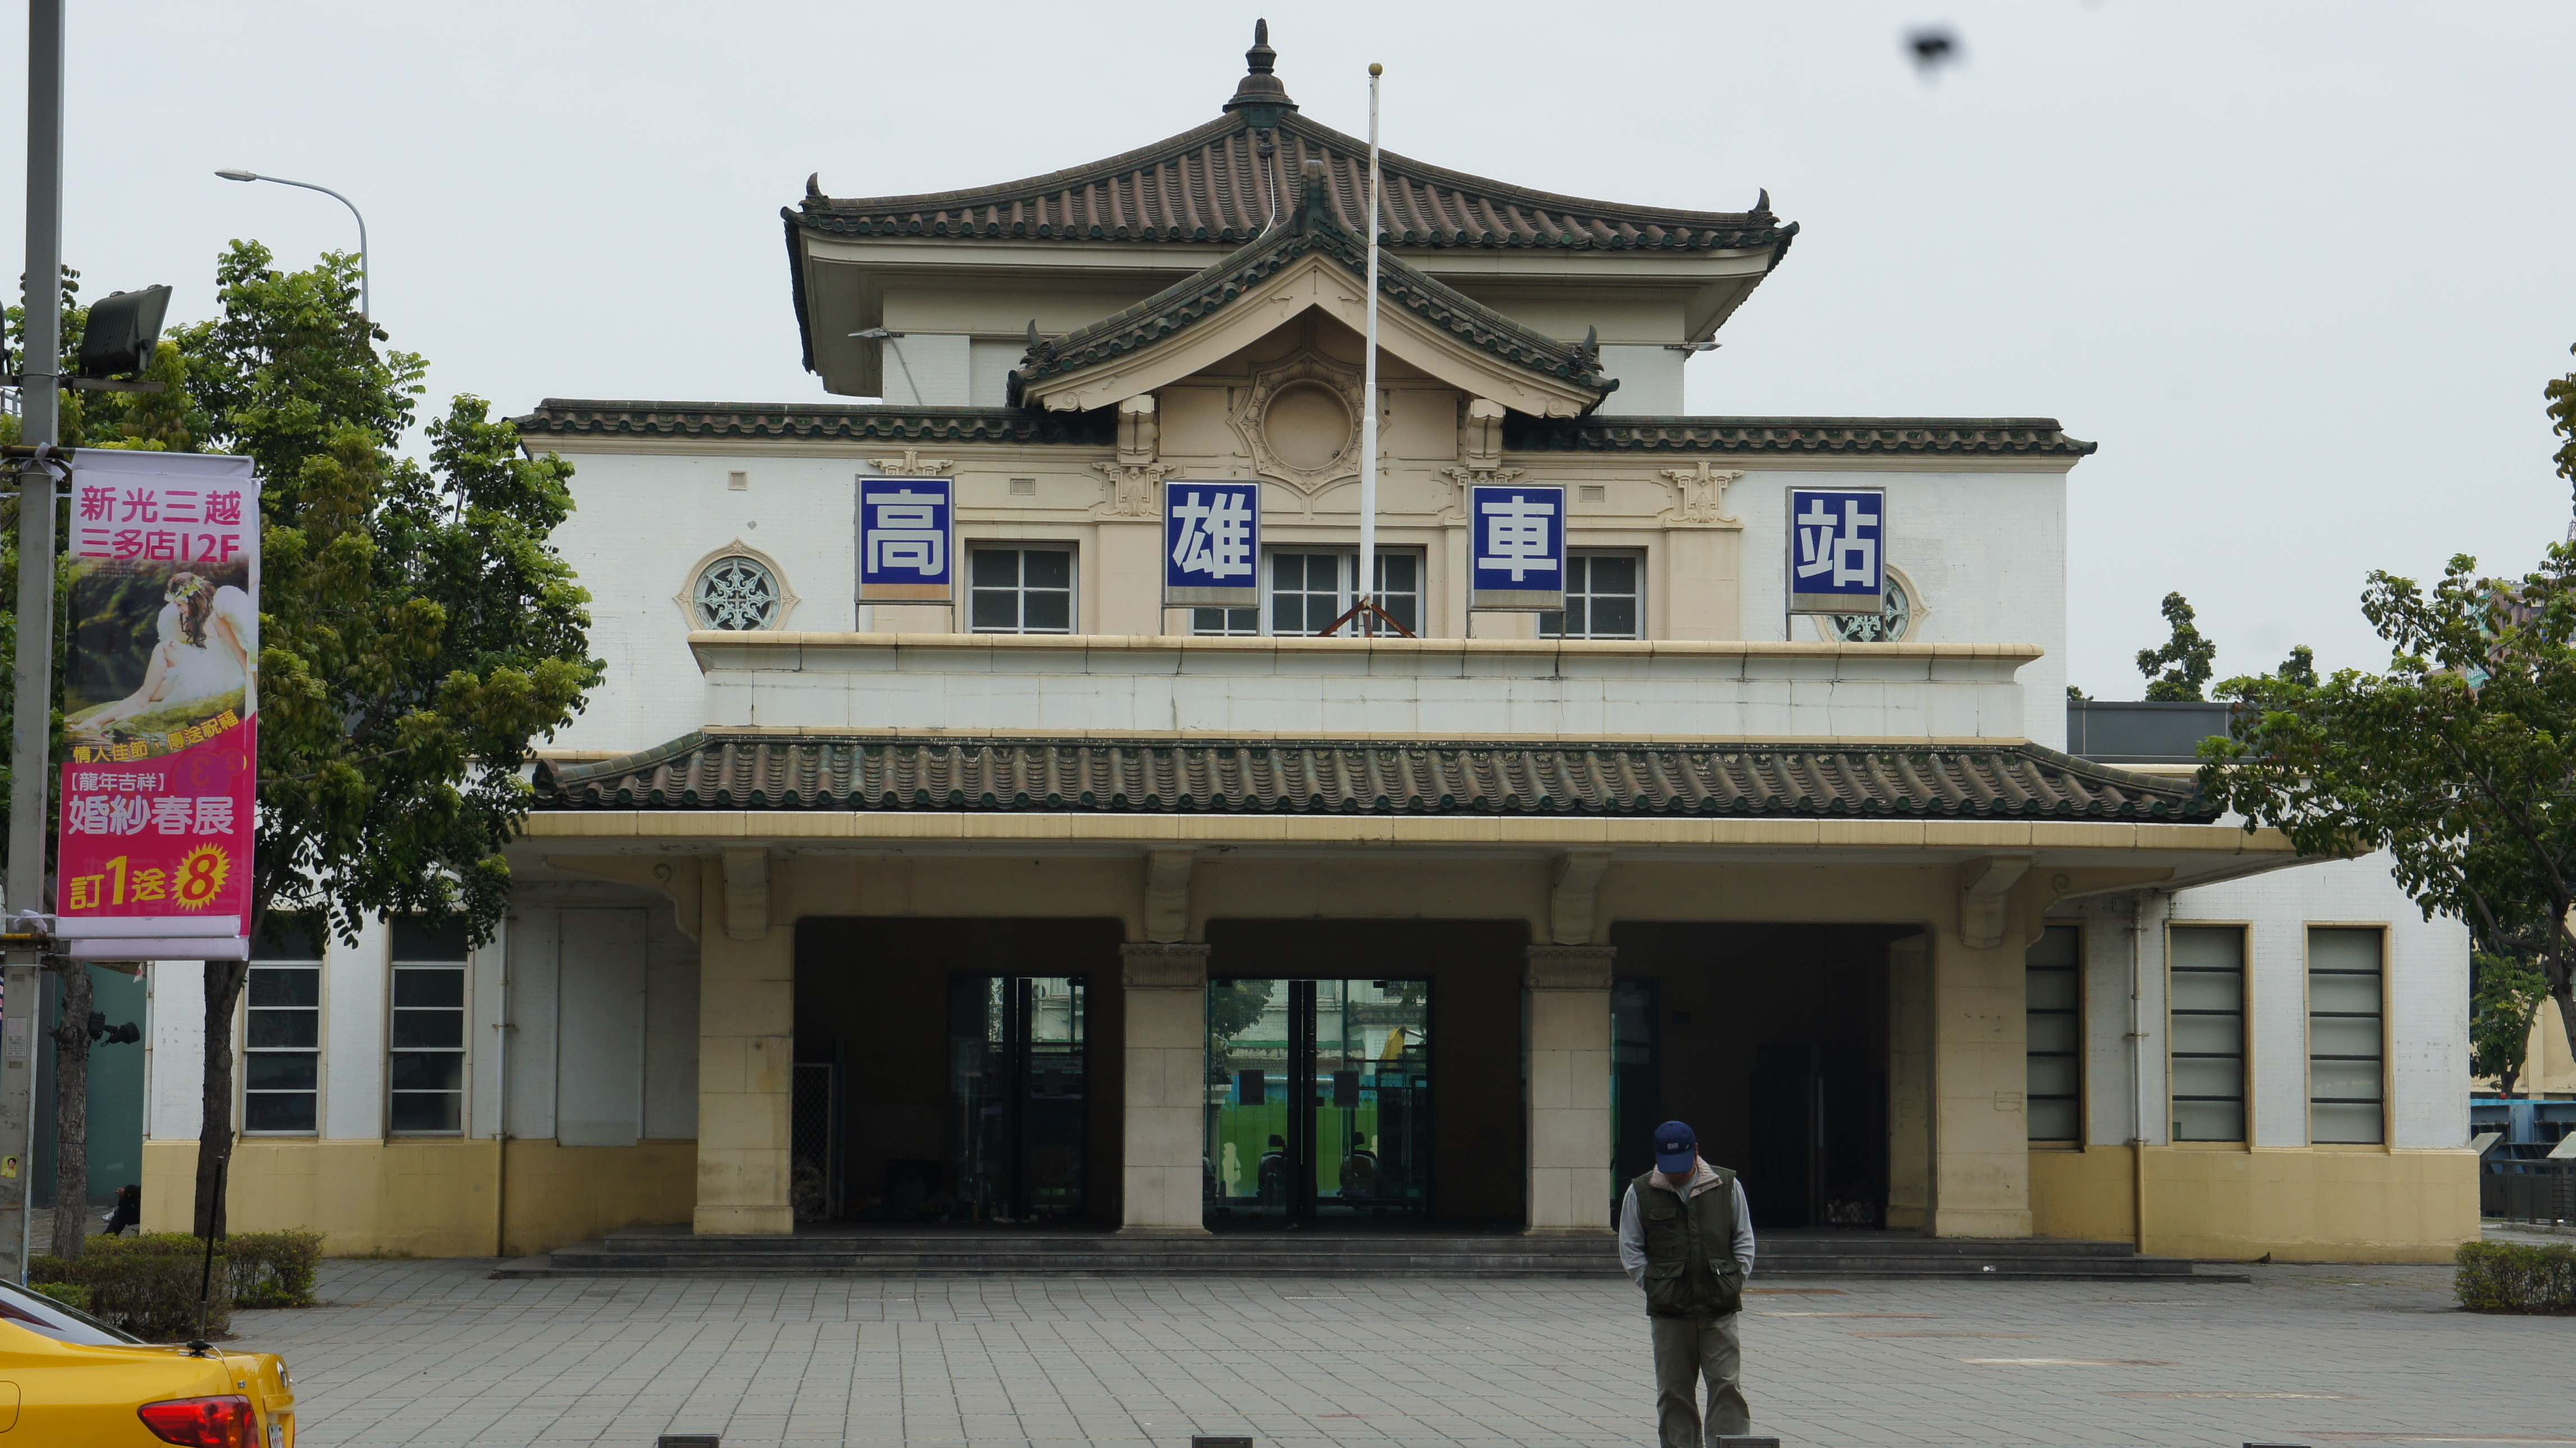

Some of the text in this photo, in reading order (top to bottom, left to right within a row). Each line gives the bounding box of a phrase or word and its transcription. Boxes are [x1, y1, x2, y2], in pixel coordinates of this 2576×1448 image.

[80, 485, 241, 525] 新光三越
[867, 489, 1878, 587] 高 雄 車 站
[68, 795, 234, 835] 婚紗春展
